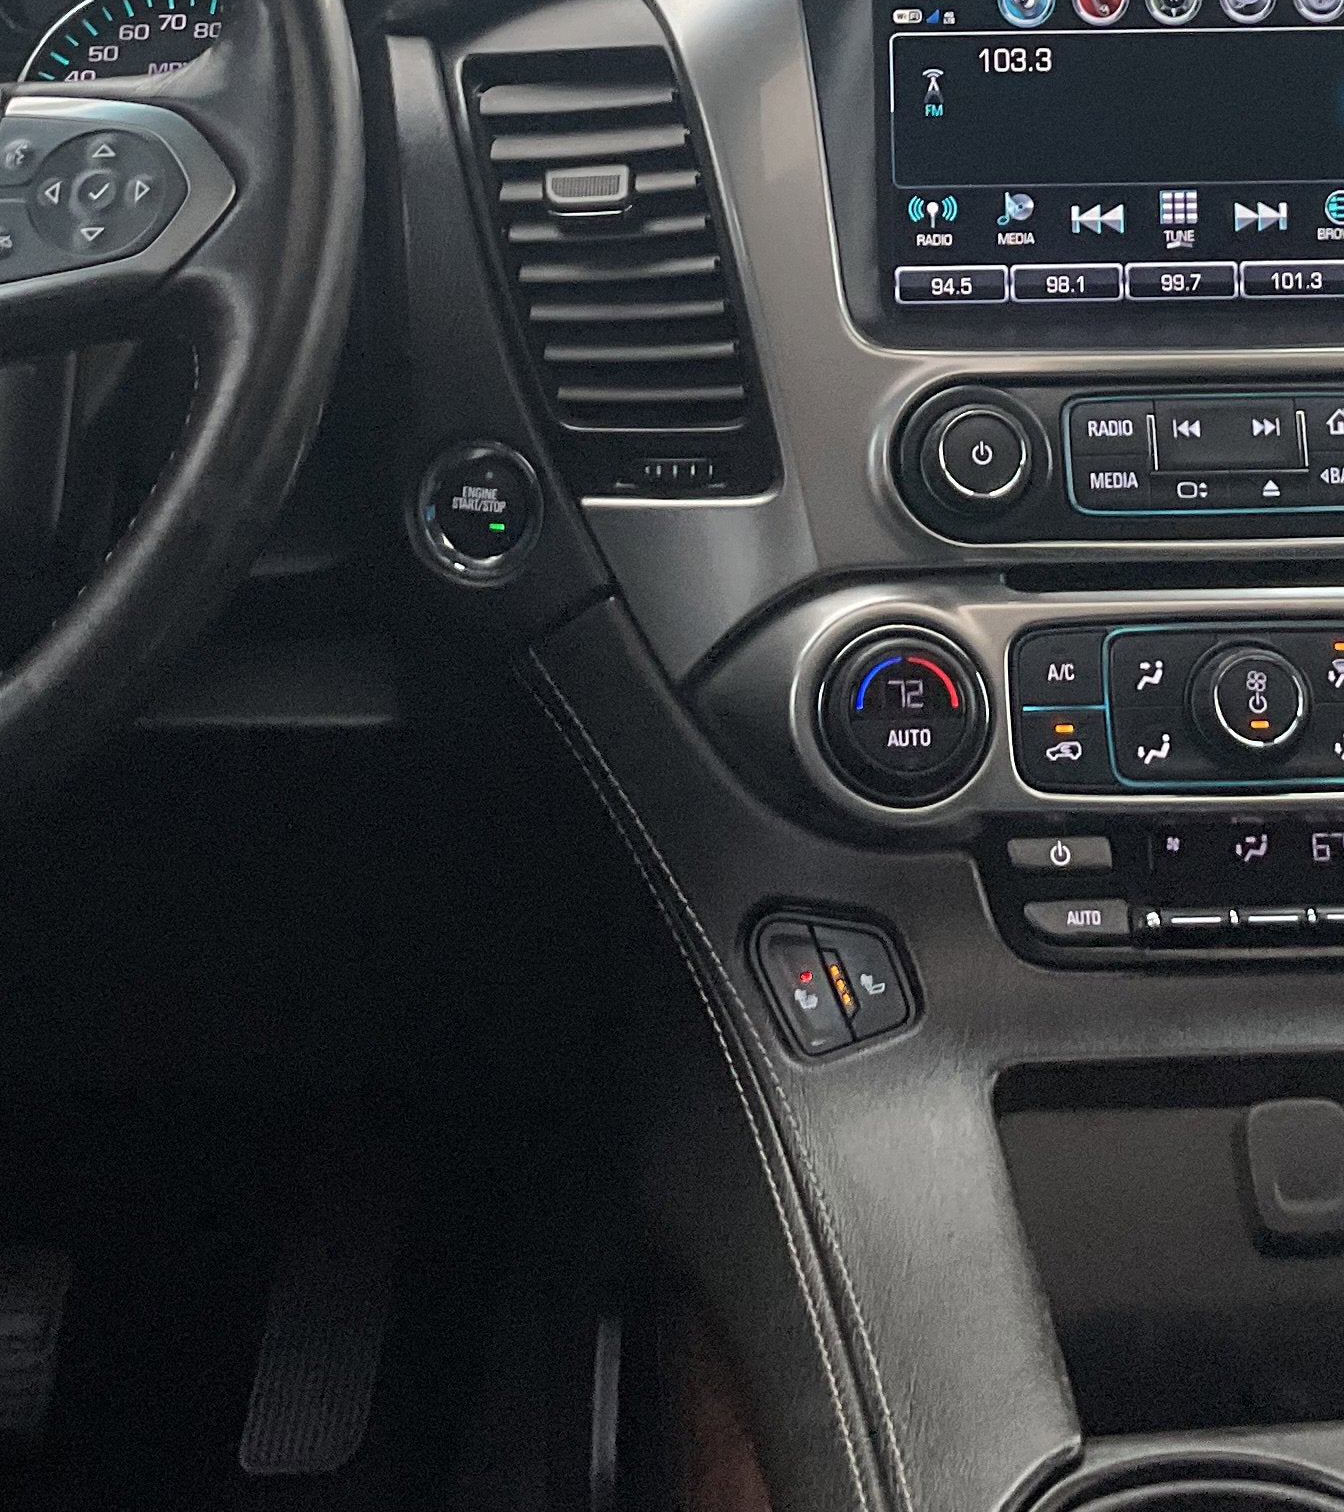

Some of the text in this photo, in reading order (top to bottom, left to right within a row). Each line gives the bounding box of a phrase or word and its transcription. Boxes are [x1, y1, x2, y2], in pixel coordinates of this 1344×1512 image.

[158, 13, 187, 30] 70
[193, 22, 222, 38] 80
[119, 24, 150, 40] 60
[88, 46, 119, 62] 50
[979, 47, 1052, 72] 103.3
[924, 104, 944, 117] FM
[916, 234, 953, 247] RADIO
[997, 232, 1035, 245] MEDIA
[1163, 229, 1195, 242] TUNE
[931, 276, 973, 295] 94.5
[1046, 275, 1085, 293] 98.1
[1161, 273, 1201, 292] 99.7
[1271, 271, 1323, 290] 101.3
[1088, 420, 1134, 438] RADIO
[1090, 472, 1139, 490] MEDIA
[462, 486, 498, 500] ENGINE
[452, 497, 506, 513] START/STOP
[1047, 663, 1075, 682] A/C
[887, 680, 924, 709] 72
[887, 728, 931, 748] AUTO
[1067, 910, 1102, 926] AUTO
